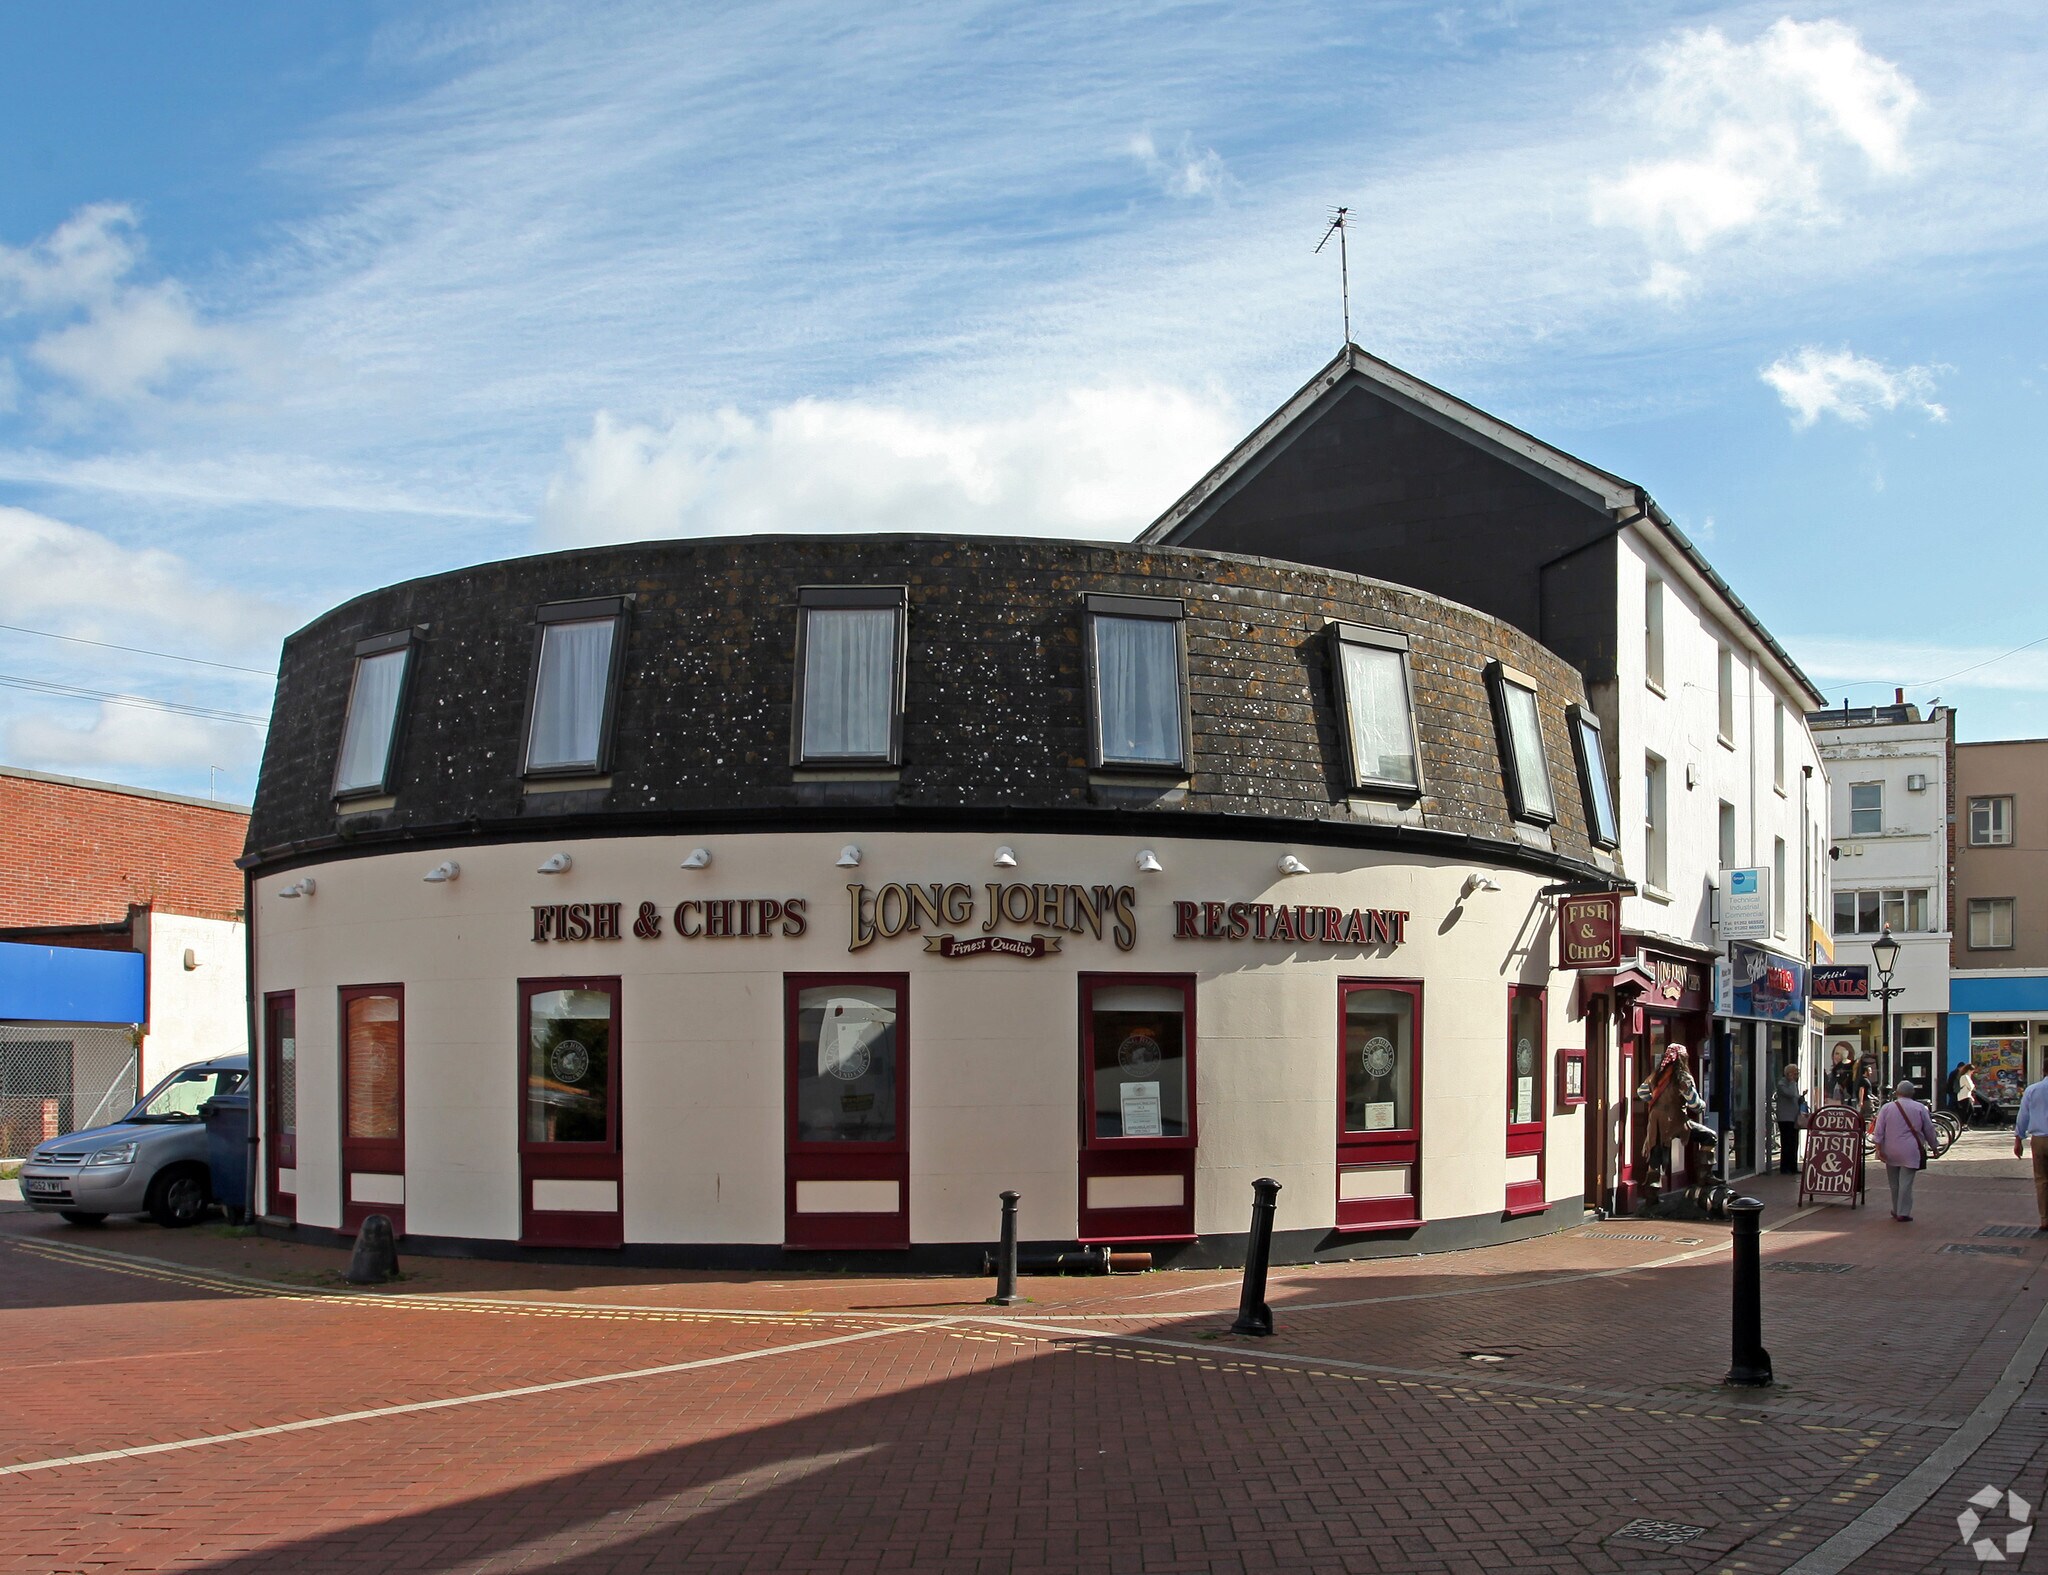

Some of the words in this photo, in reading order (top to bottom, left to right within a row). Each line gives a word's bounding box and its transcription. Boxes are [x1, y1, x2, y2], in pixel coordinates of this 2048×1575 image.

[1729, 896, 1760, 904] Technical
[531, 902, 621, 942] FISH
[633, 901, 661, 939] &
[674, 899, 807, 938] CHIPS
[846, 883, 974, 952] LONG
[982, 883, 1137, 951] JOHN'S
[1173, 900, 1410, 945] RESTAURANT
[1568, 904, 1608, 924] FISH
[1724, 911, 1764, 919] Commercial
[1580, 923, 1597, 938] &
[949, 939, 986, 956] Finest
[990, 937, 1036, 957] Quality
[1568, 939, 1610, 960] CHIPS
[1813, 969, 1848, 981] Artist
[1813, 979, 1868, 997] NAILS
[1815, 1115, 1855, 1129] OPEN
[1809, 1136, 1856, 1163] FISH
[1821, 1152, 1842, 1173] &
[1806, 1163, 1853, 1192] CHIPS
